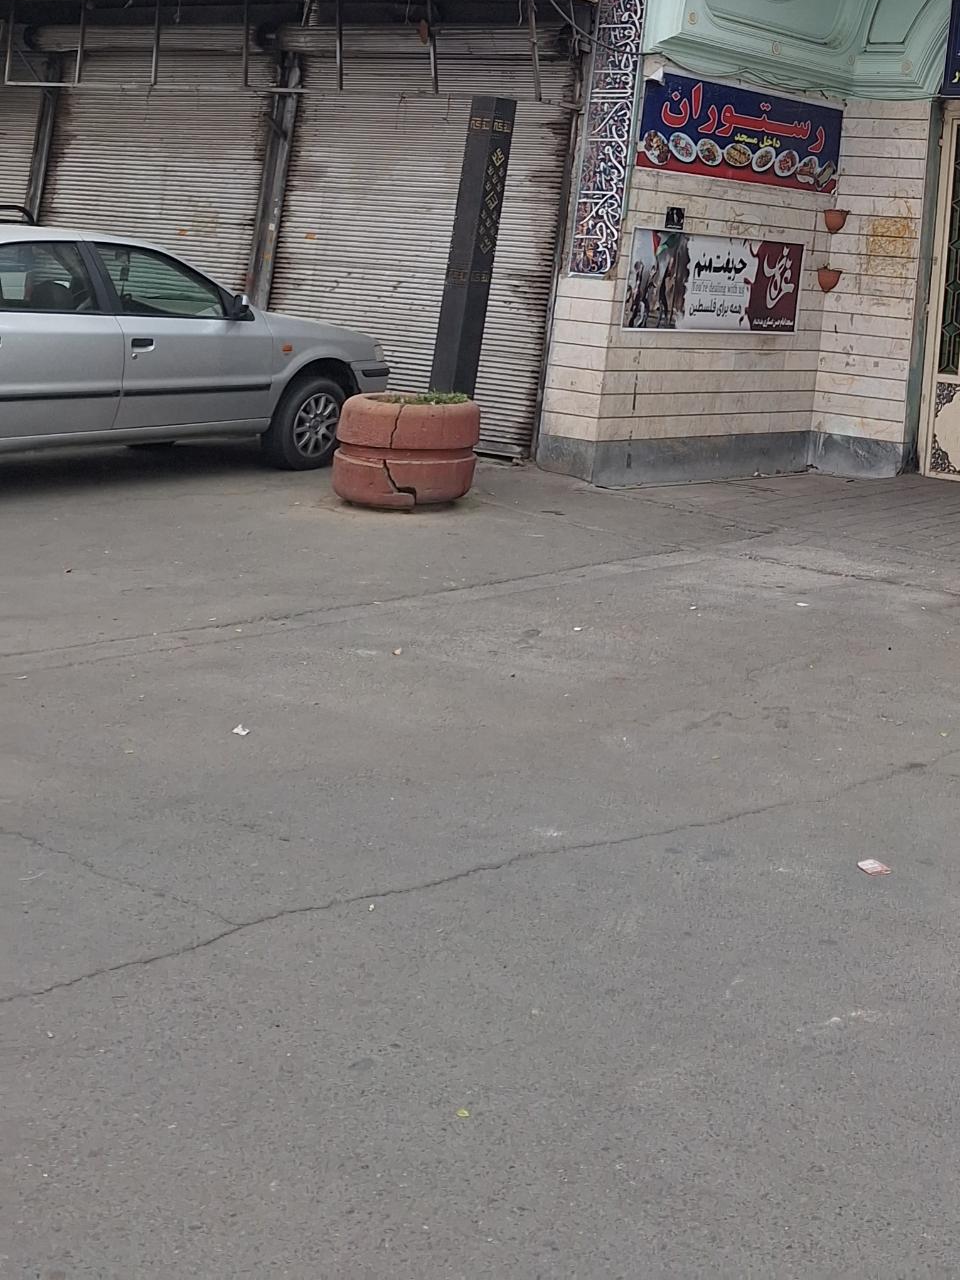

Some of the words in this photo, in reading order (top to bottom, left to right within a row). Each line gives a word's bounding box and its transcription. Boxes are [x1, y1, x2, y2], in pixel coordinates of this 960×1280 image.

[661, 82, 826, 155] رستوران
[734, 131, 759, 146] مسجد
[758, 134, 781, 149] داخل
[688, 297, 717, 317] فلسطین
[716, 299, 729, 318] برای
[729, 303, 742, 315] همه
